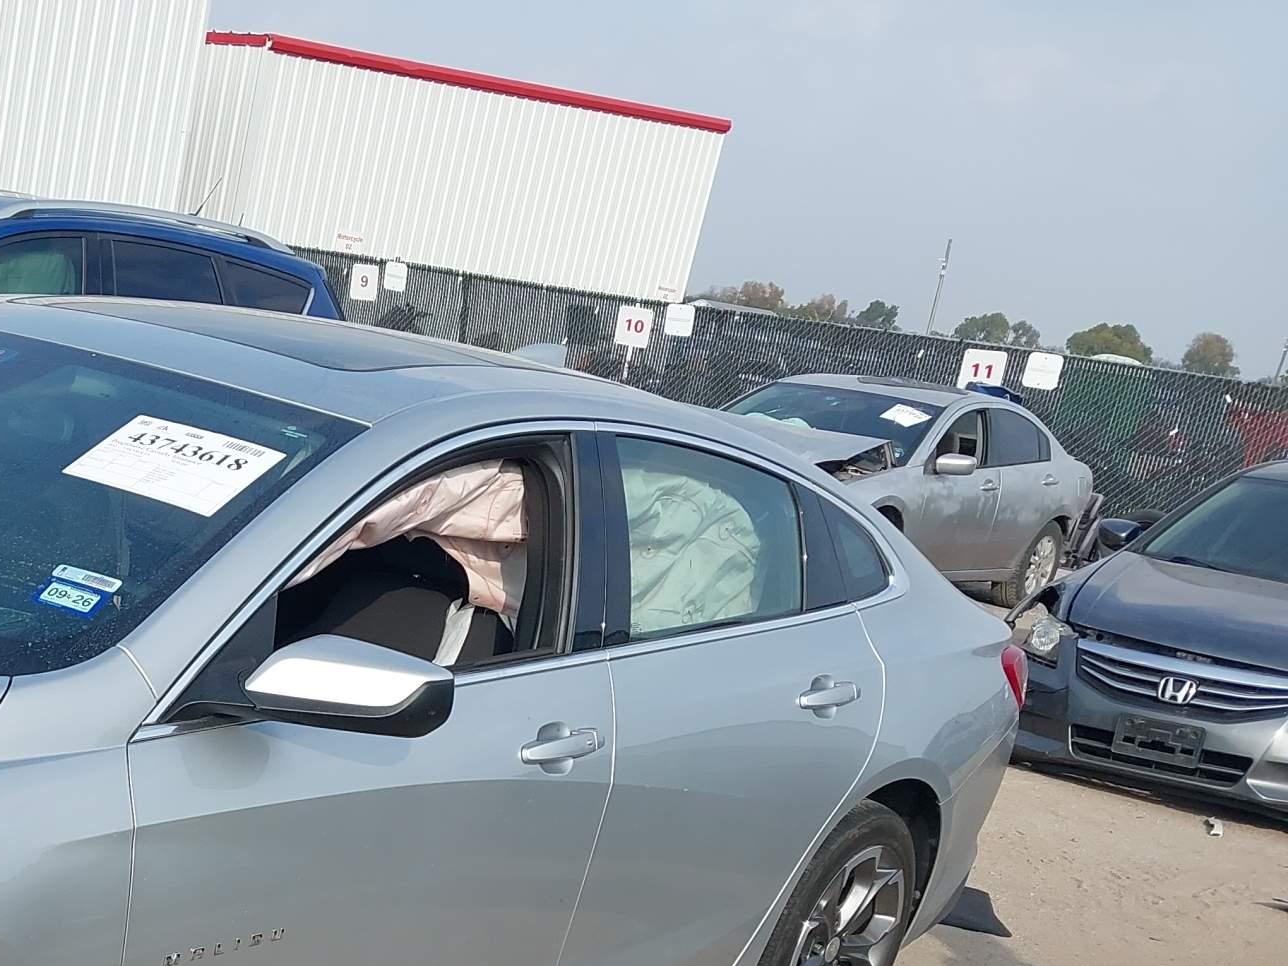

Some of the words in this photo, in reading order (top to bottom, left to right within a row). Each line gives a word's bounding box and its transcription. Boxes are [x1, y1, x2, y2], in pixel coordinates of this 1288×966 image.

[360, 275, 369, 288] 9
[626, 319, 645, 333] 10
[971, 363, 994, 379] 11
[128, 432, 249, 471] 43743618
